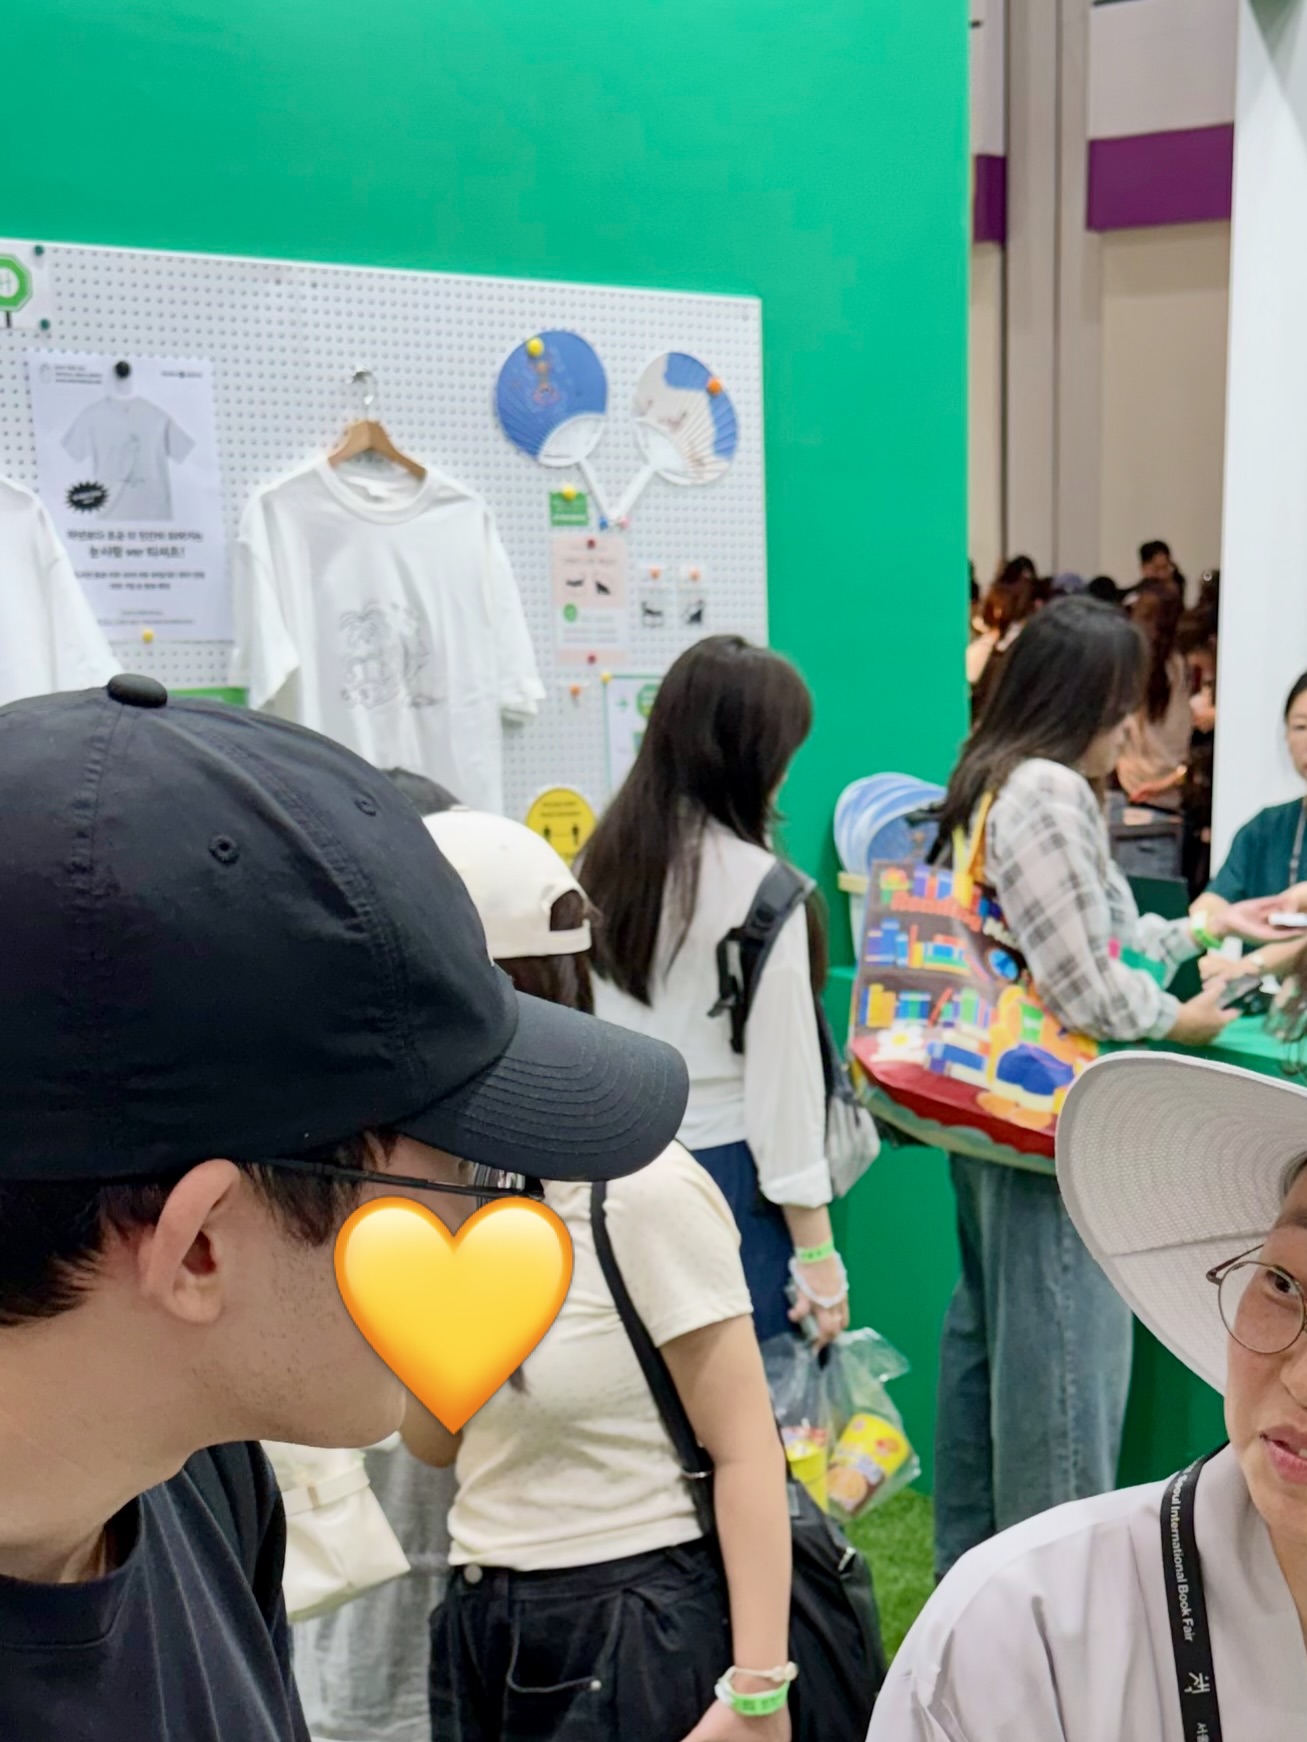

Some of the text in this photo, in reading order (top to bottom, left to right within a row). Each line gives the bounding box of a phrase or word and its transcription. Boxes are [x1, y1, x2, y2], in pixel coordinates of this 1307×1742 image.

[1170, 1473, 1196, 1642] Seoul International Book Fair
